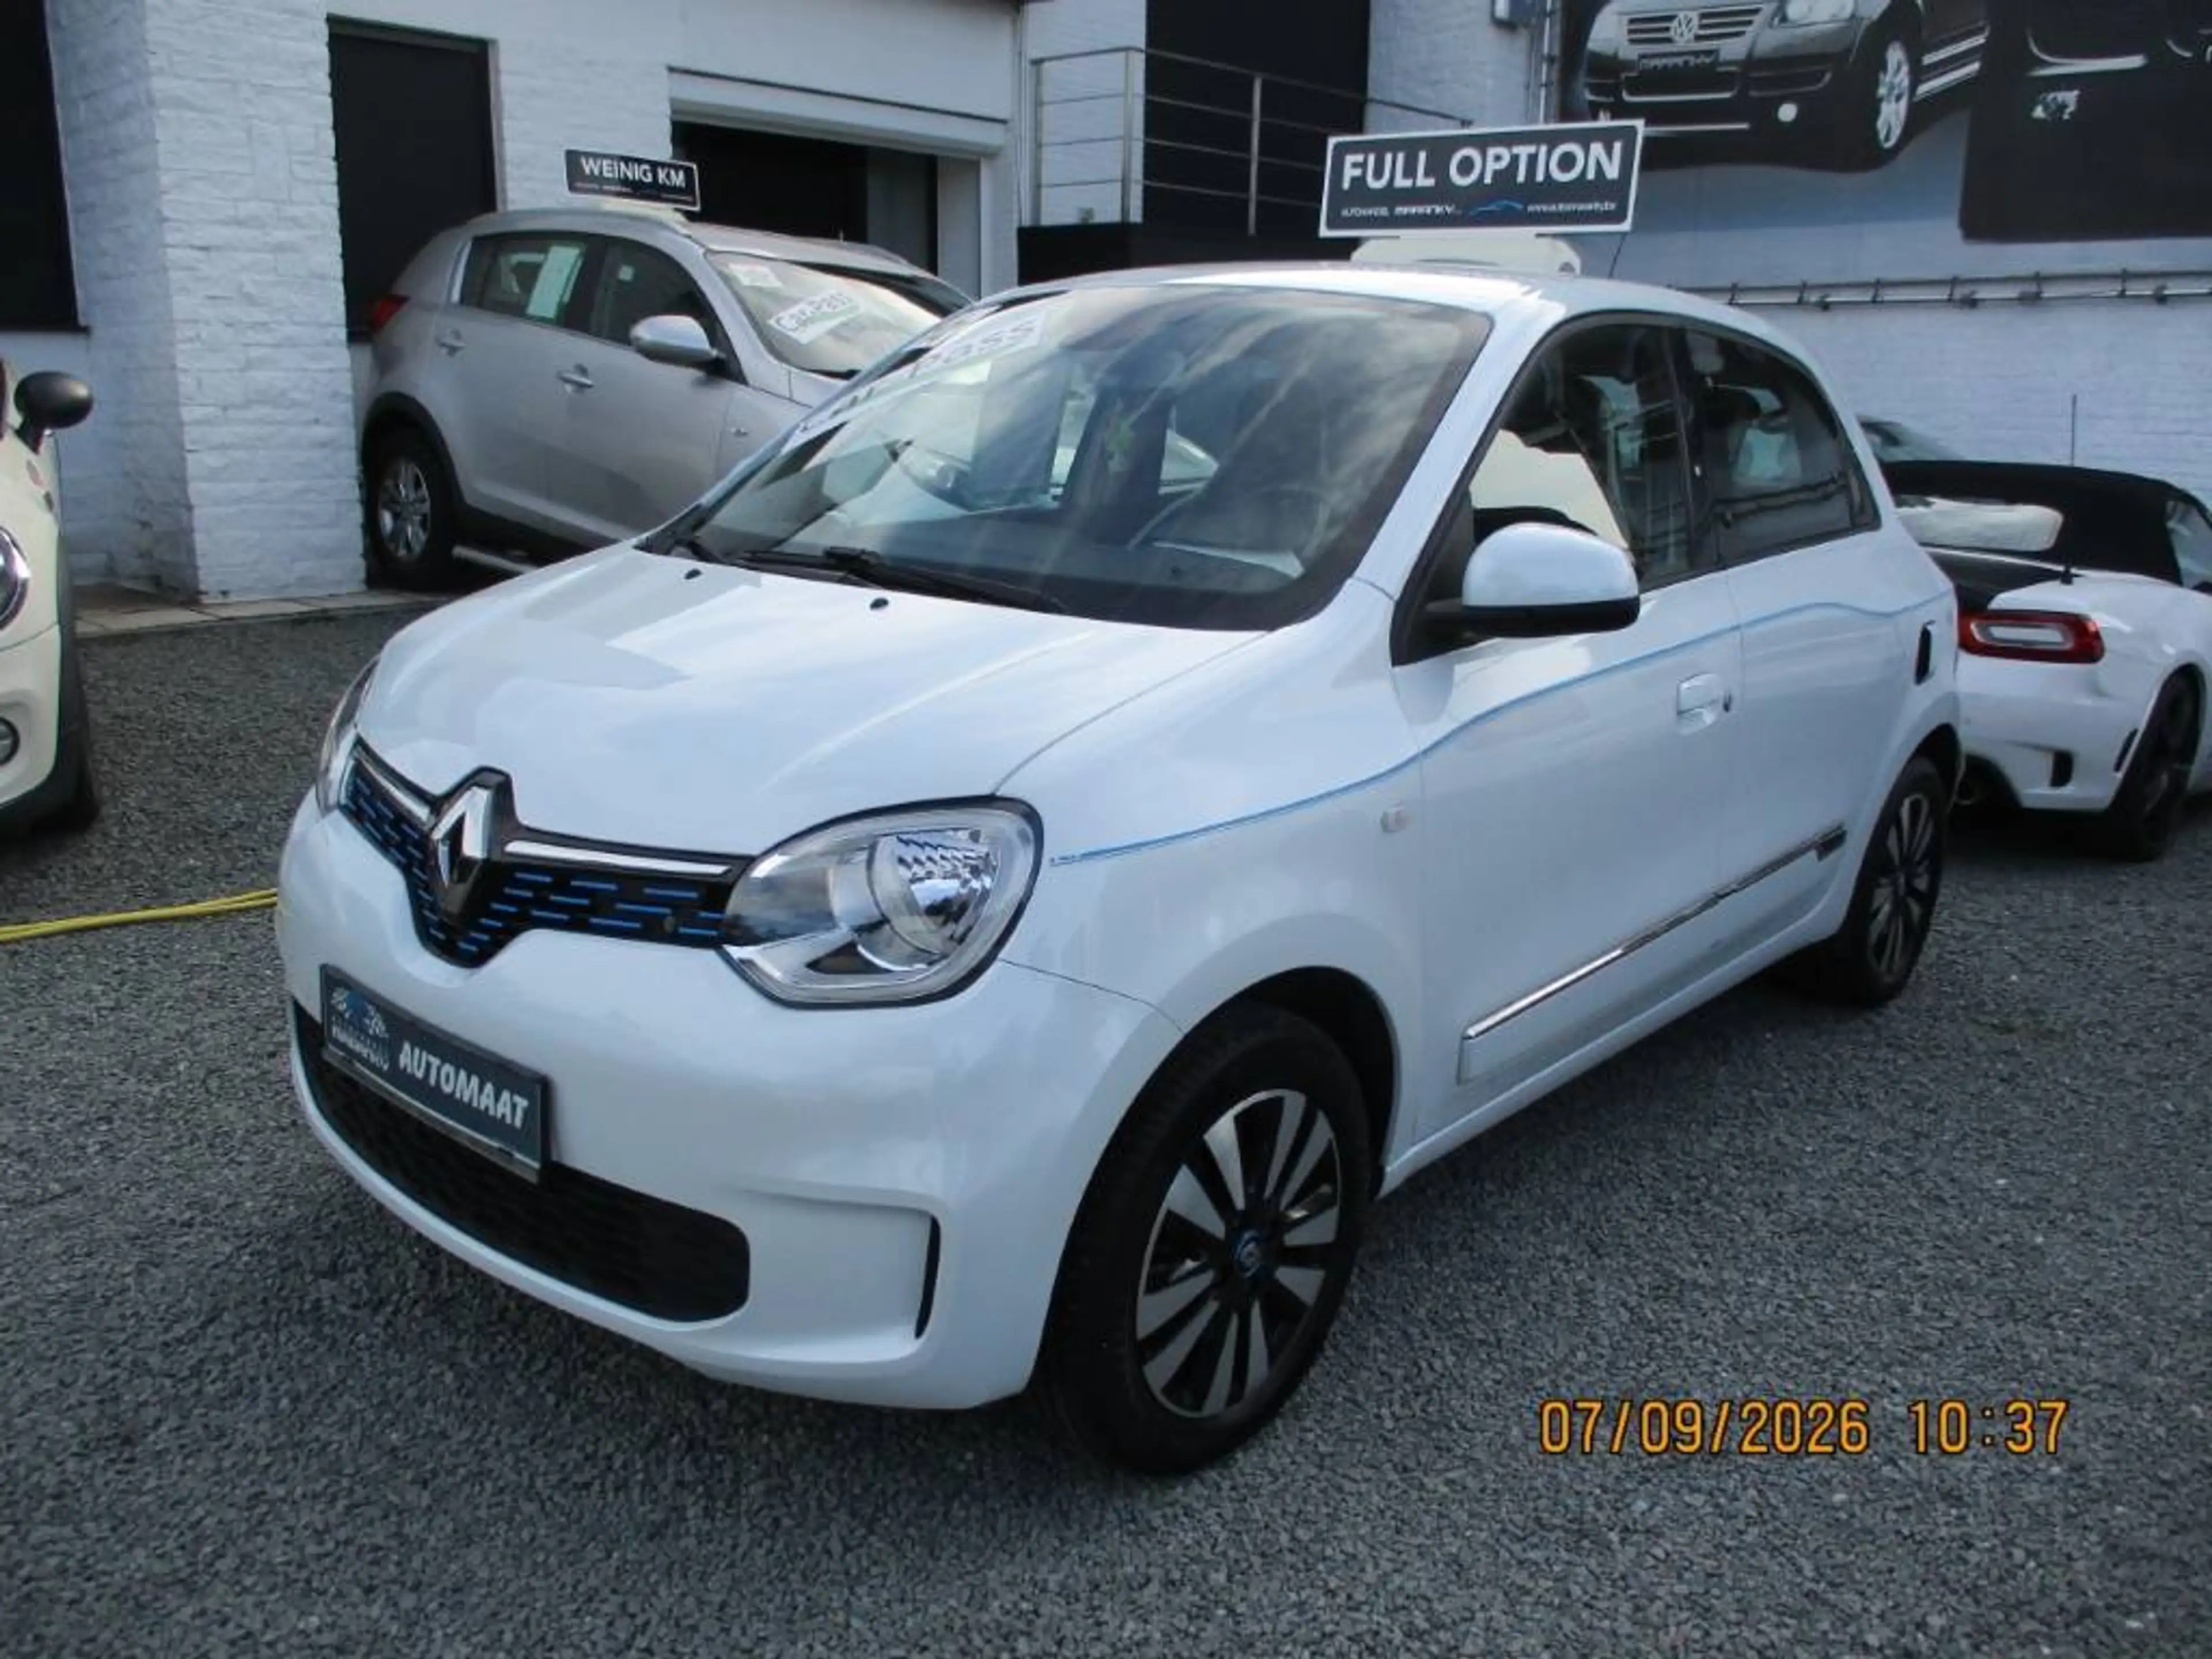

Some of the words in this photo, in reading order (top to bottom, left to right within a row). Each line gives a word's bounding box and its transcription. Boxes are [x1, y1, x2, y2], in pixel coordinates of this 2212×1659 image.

[581, 156, 653, 183] WEINIG
[657, 166, 685, 188] KM
[1340, 150, 1435, 191] FULL
[1449, 141, 1622, 187] OPTION
[399, 1040, 529, 1129] AUTOMAAT
